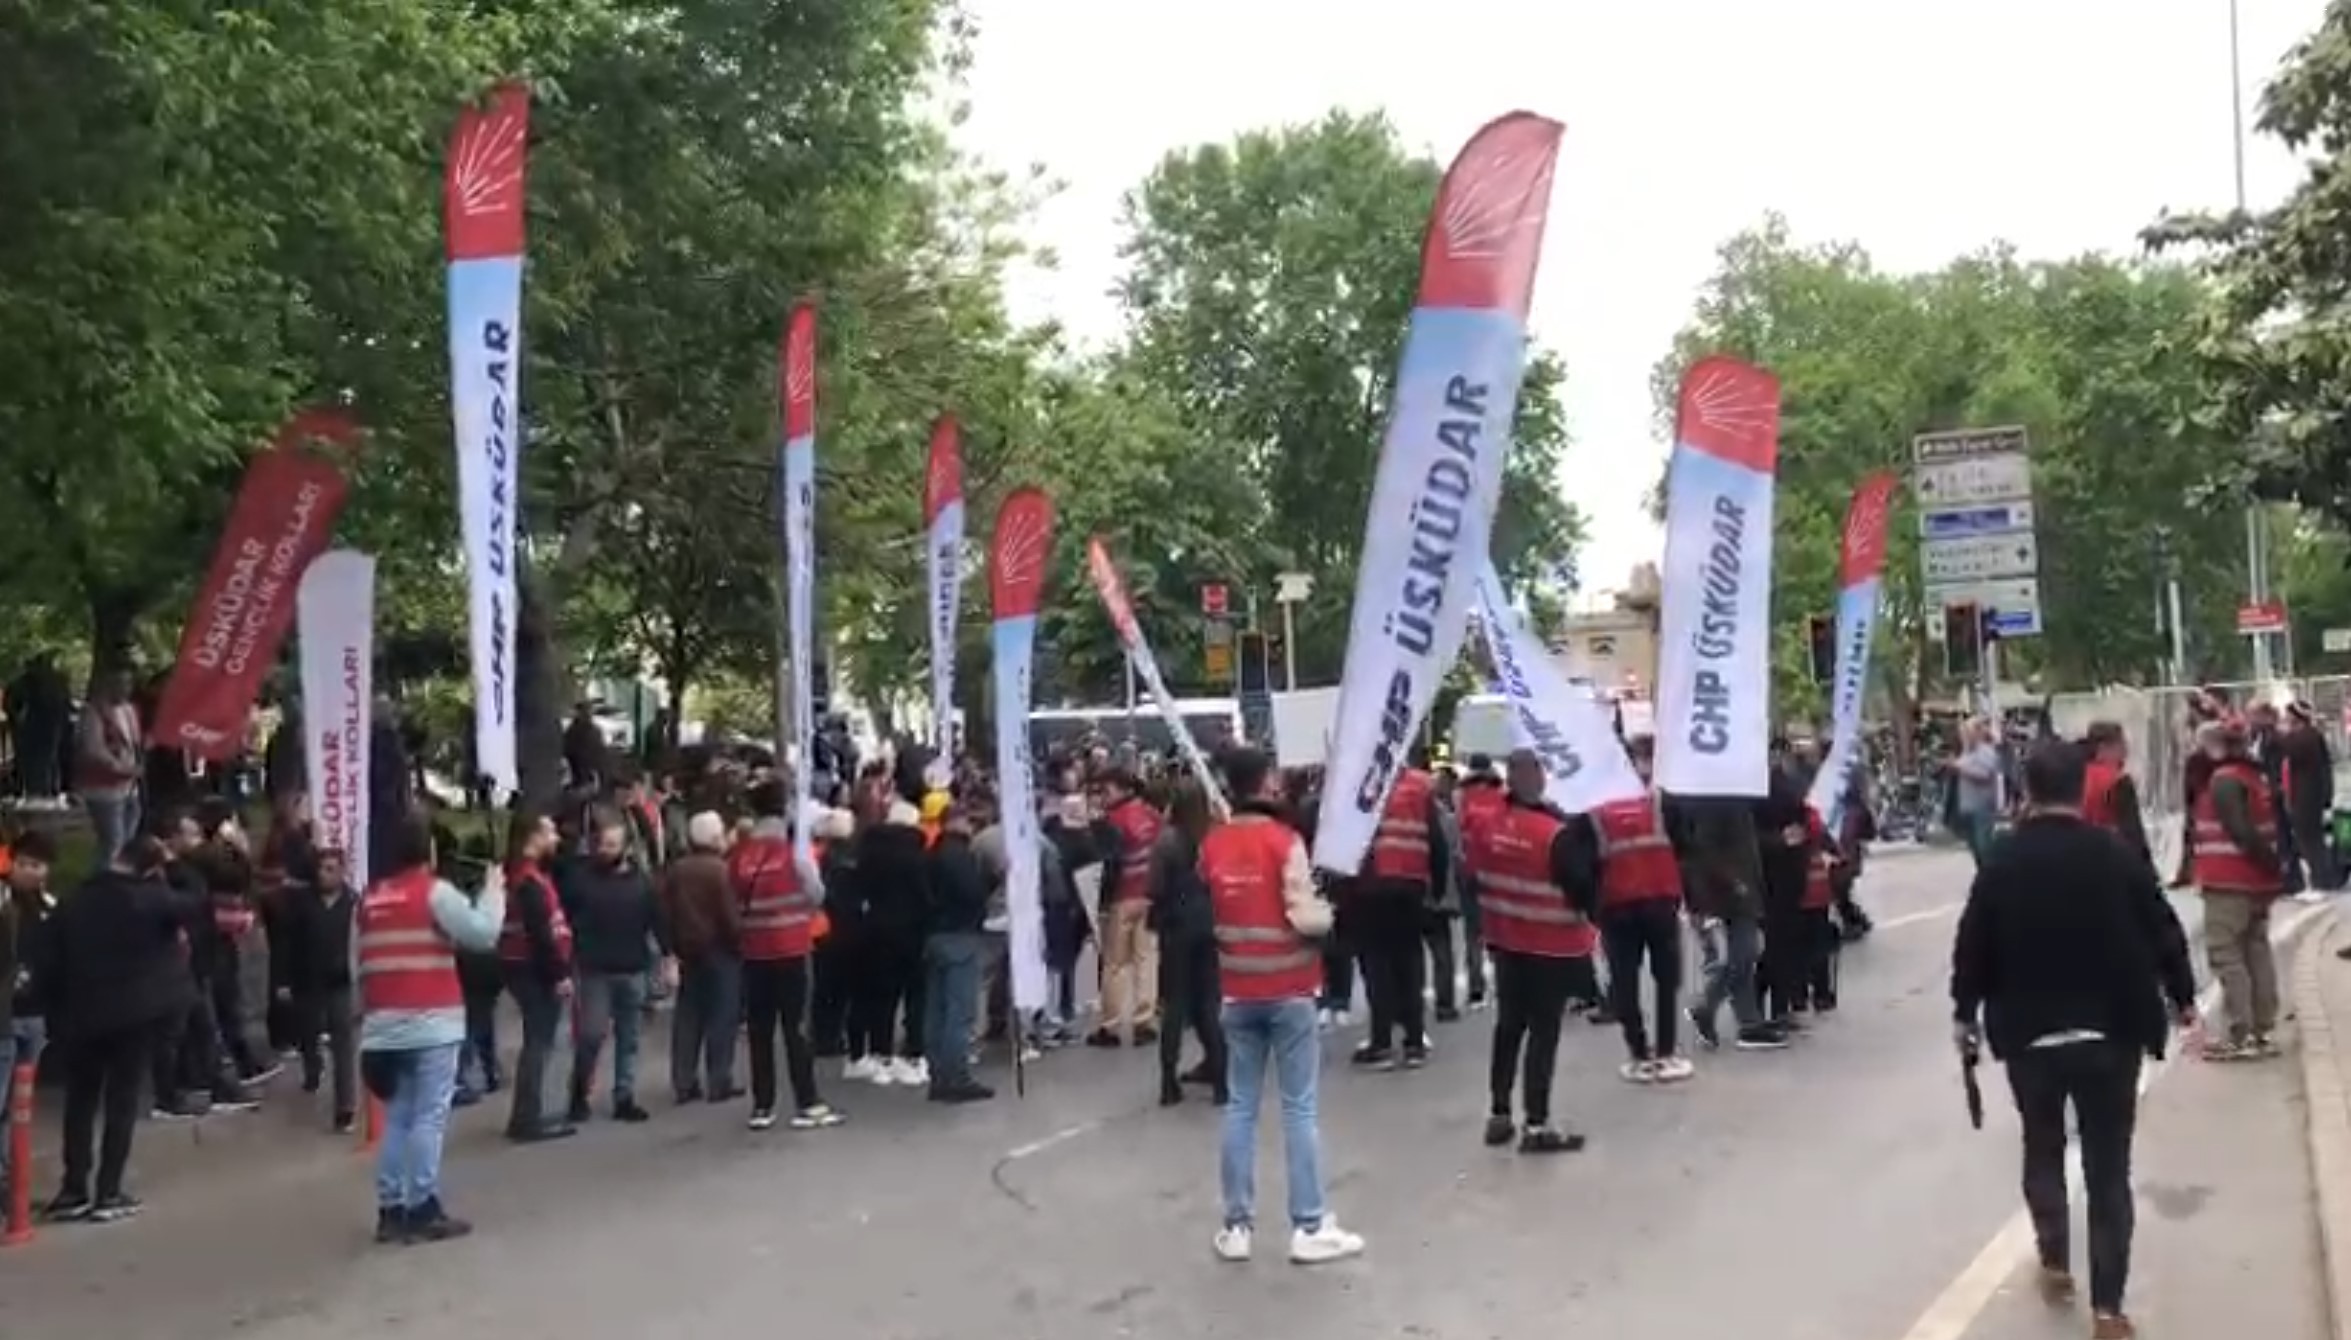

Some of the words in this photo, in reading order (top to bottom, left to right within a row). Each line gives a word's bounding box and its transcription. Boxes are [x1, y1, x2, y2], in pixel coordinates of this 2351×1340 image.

[1383, 374, 1489, 657] ÜSKÜDAR
[1692, 495, 1746, 660] ÜSKÜDAR
[1356, 668, 1412, 814] CHP
[1689, 670, 1730, 754] CHP
